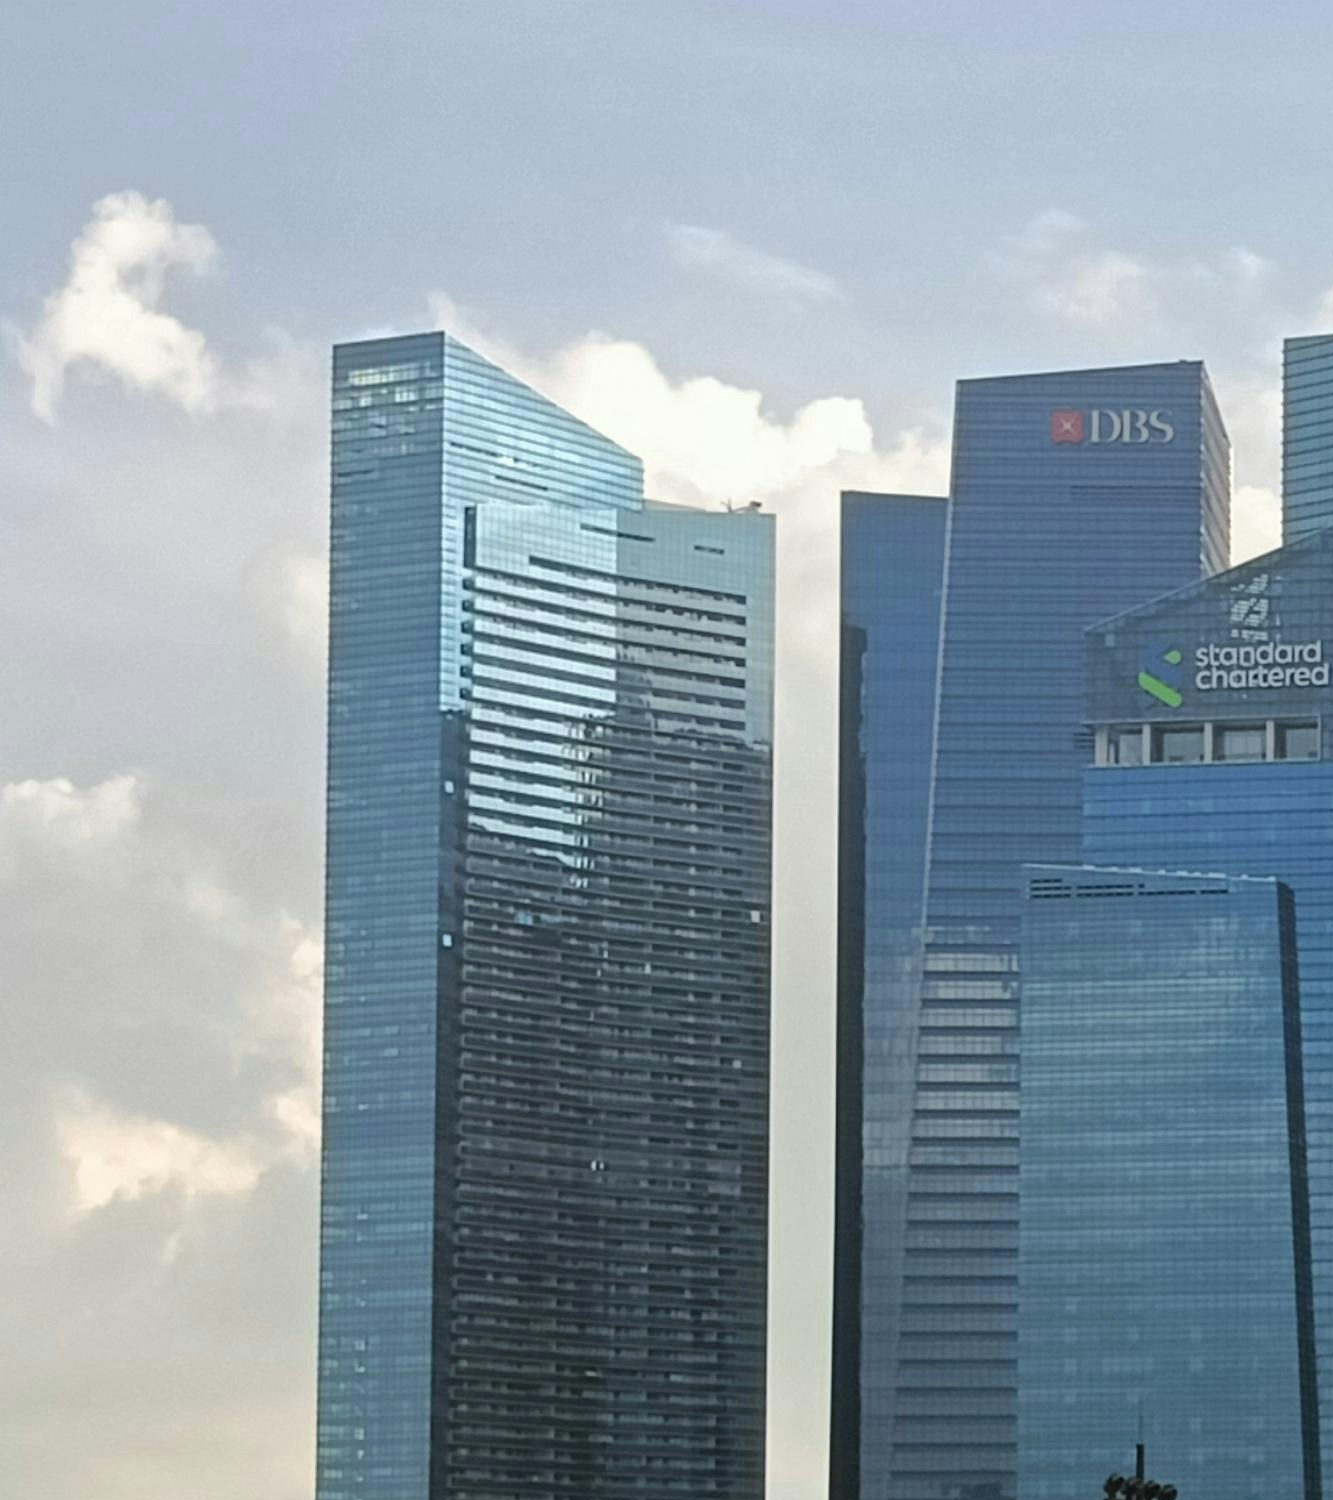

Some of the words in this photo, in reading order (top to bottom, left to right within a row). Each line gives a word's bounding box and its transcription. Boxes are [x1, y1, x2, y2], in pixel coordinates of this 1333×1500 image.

[1090, 408, 1175, 444] DBS
[1195, 640, 1322, 667] standard
[1195, 662, 1330, 690] chartered
